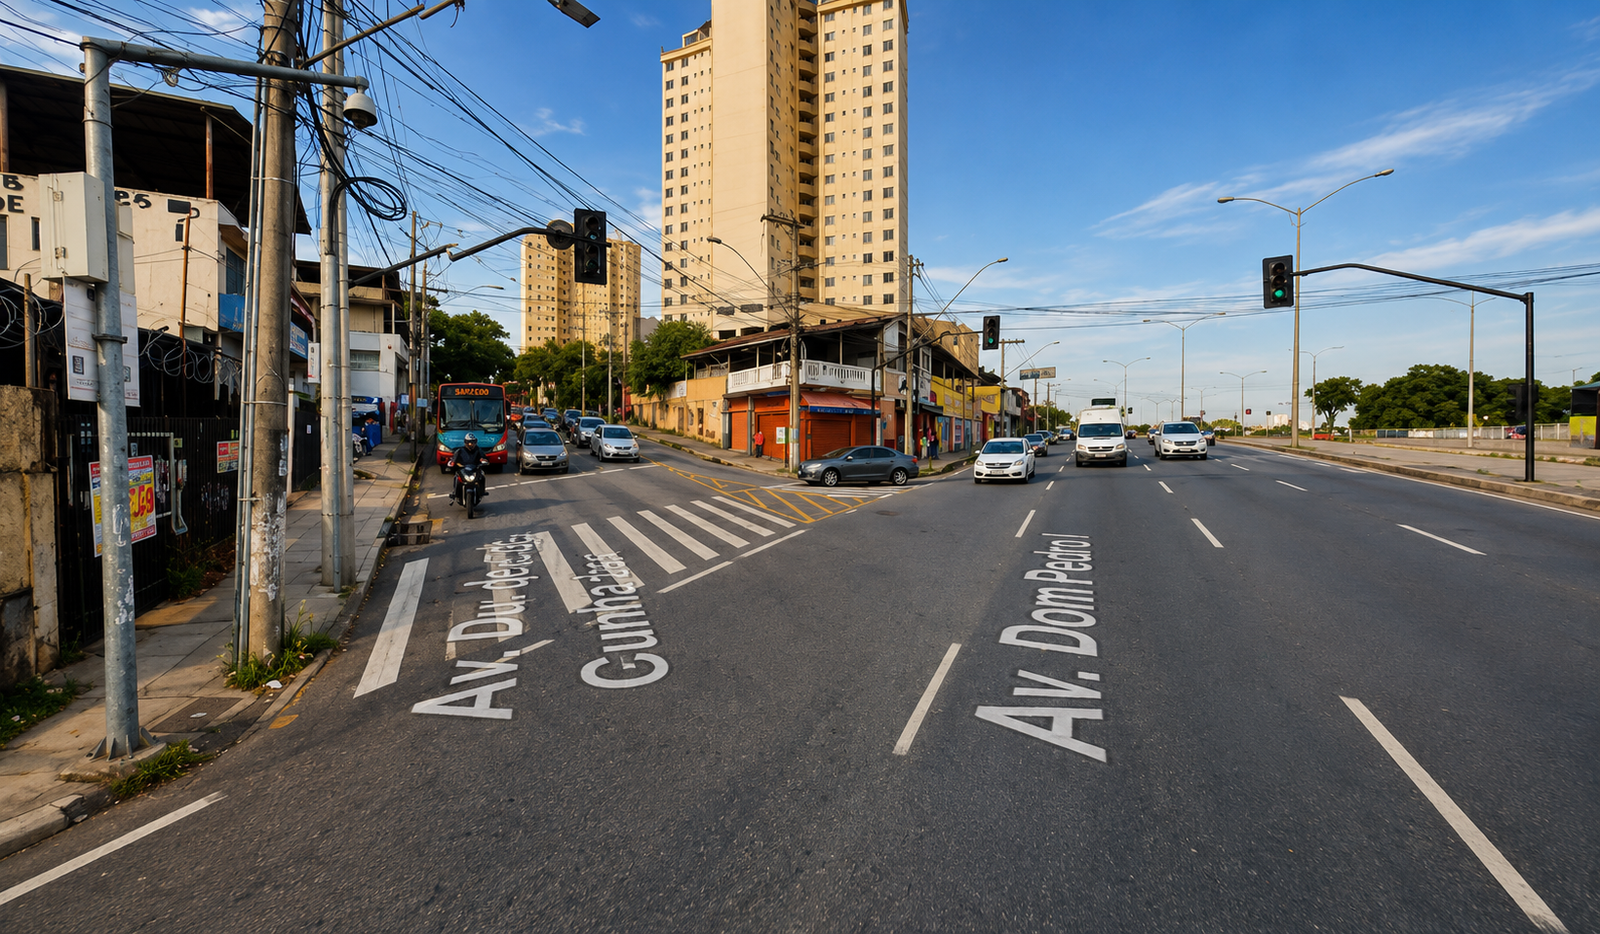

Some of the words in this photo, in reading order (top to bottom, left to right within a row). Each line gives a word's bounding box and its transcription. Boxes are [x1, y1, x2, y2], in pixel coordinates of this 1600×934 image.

[1024, 540, 1093, 585] Pedro
[999, 587, 1098, 657] Dom
[411, 650, 521, 720] Av.
[974, 669, 1107, 763] Av.
